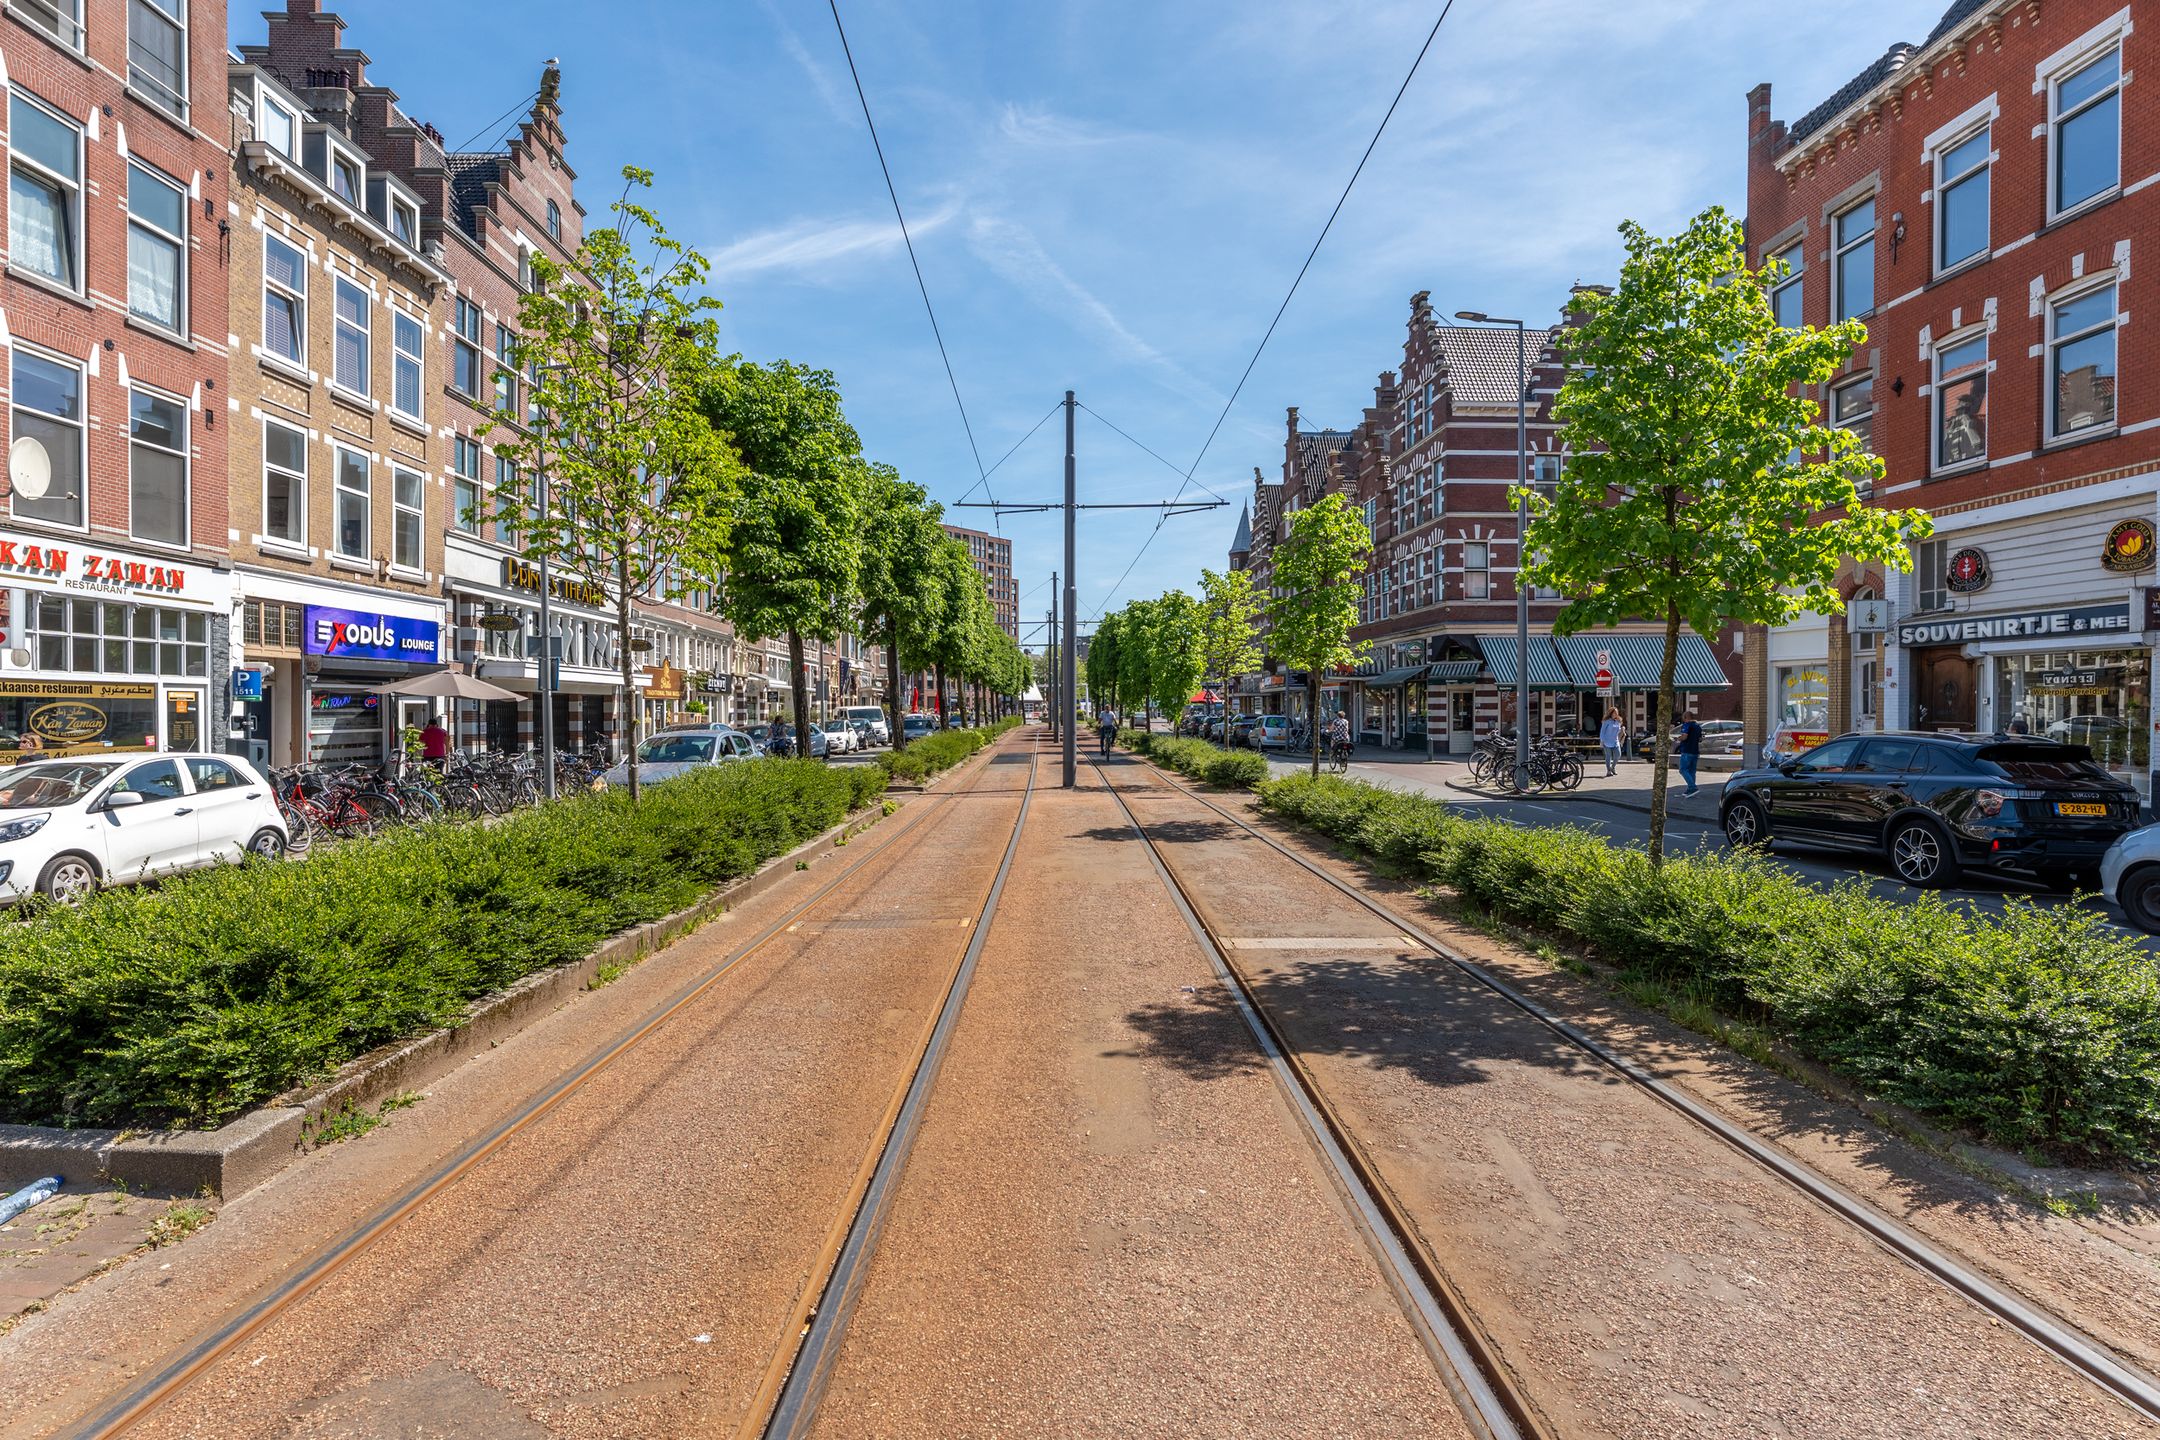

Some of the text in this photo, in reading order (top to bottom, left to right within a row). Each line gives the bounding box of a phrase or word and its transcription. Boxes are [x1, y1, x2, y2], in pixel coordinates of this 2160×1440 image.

[2112, 522, 2149, 539] AMY GOLD
[2114, 550, 2146, 563] TOBACCO
[0, 540, 185, 589] KAN ZAMAN
[65, 579, 128, 595] RESTAURANT
[318, 616, 434, 652] EXODUS LOUNGE
[1901, 614, 2128, 644] SOUVENIRTJE & MEE
[237, 672, 250, 686] P
[42, 684, 93, 694] restaurant
[101, 684, 152, 697] مطعم مغربي
[36, 715, 103, 729] Kan Zaman
[2061, 804, 2103, 814] S-282-HZ
